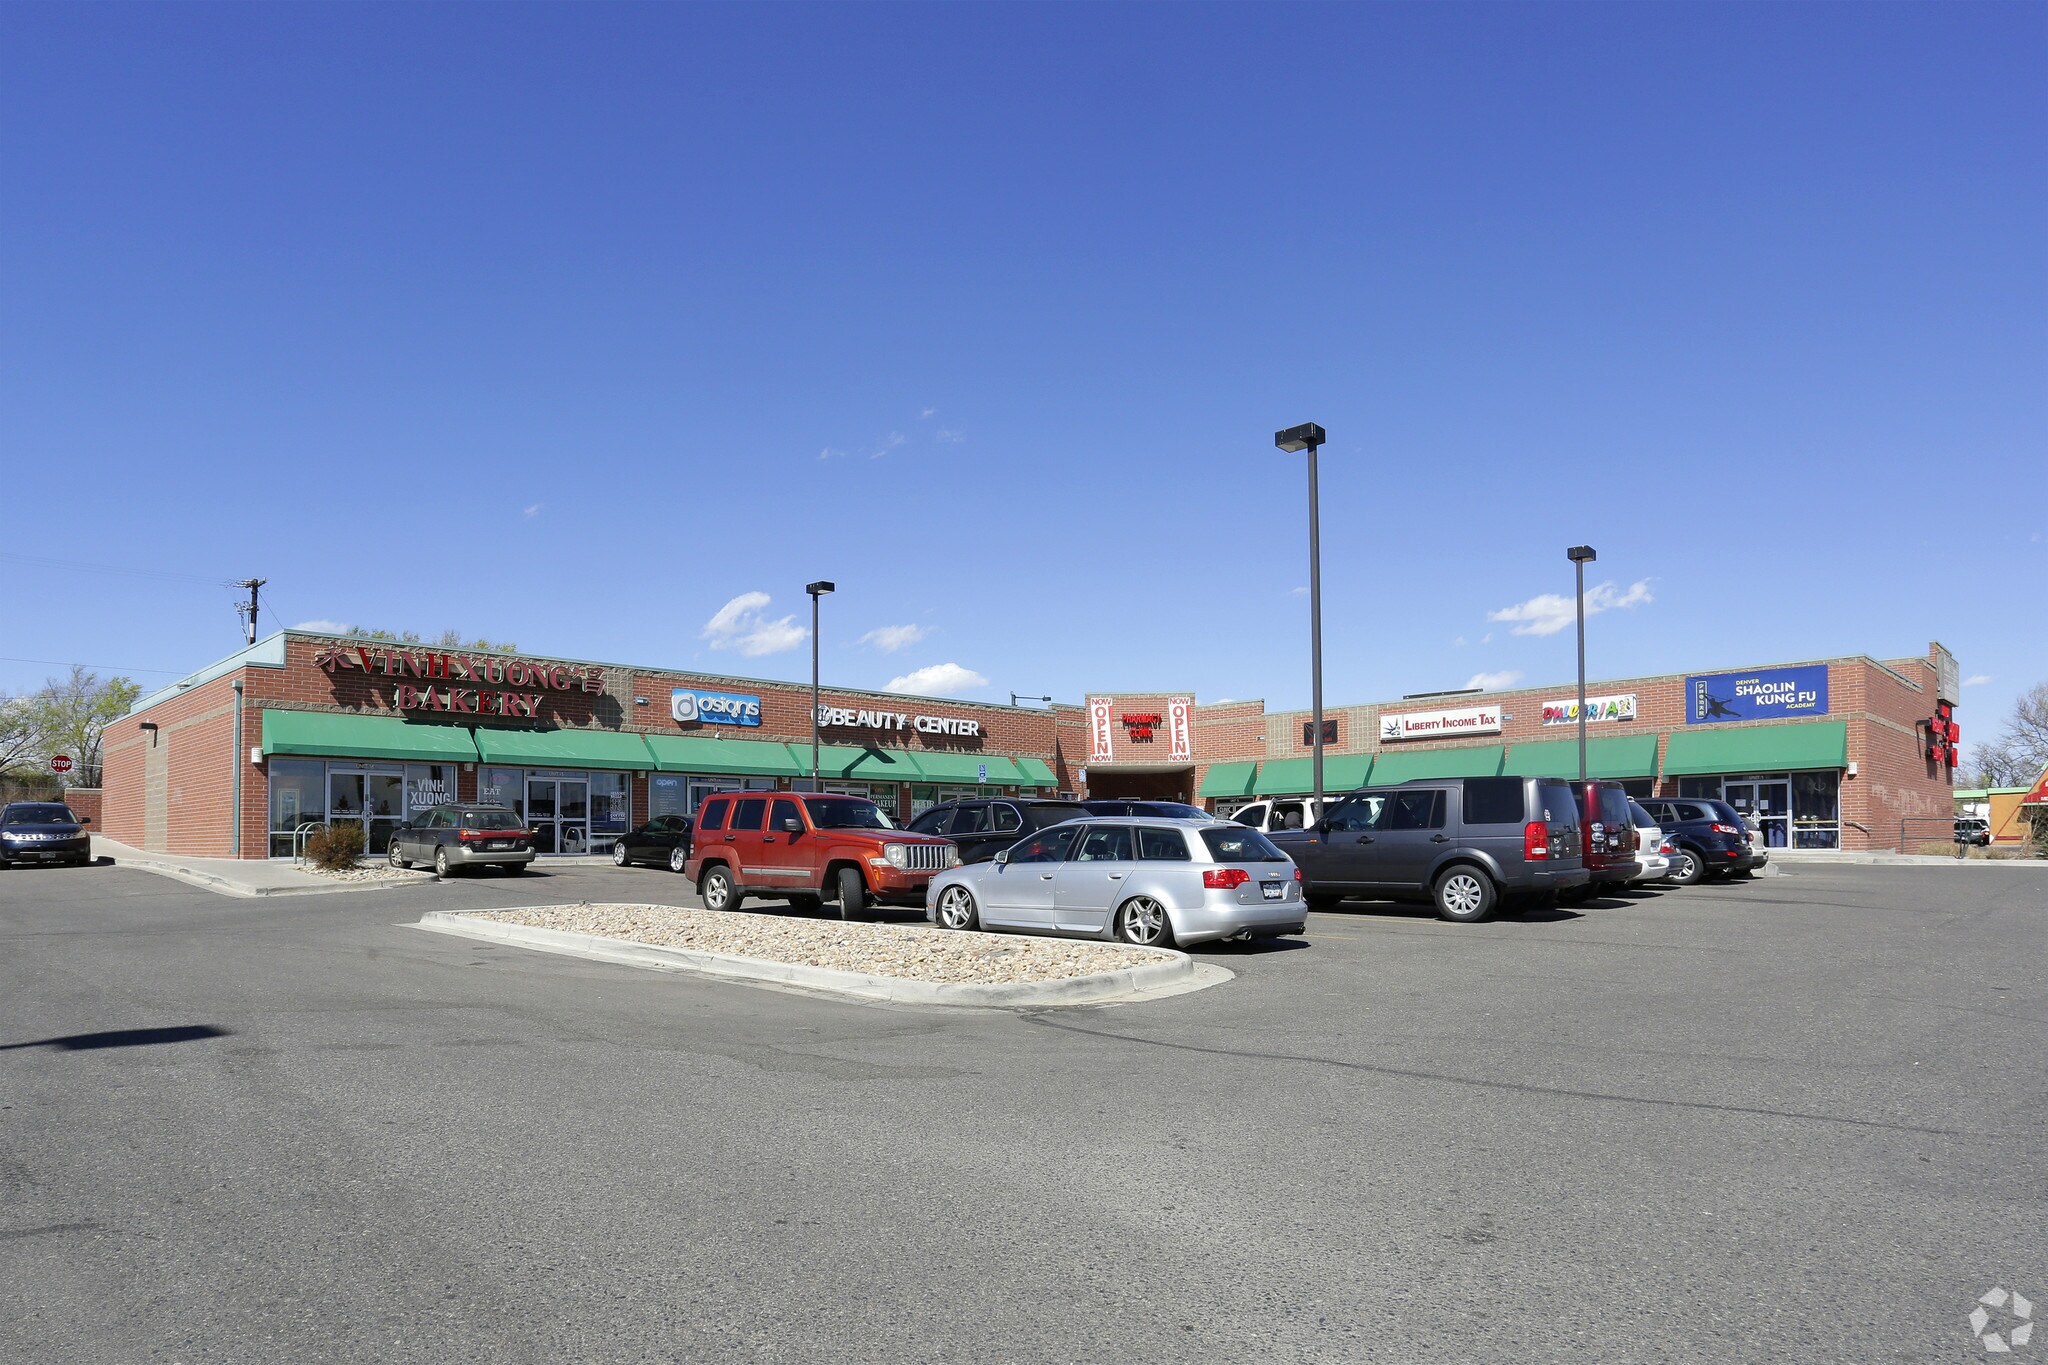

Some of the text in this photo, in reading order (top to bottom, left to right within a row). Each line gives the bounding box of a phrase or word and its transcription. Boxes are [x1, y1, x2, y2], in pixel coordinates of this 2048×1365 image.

[356, 647, 451, 679] VINH
[1736, 682, 1795, 696] SHAOLIN
[393, 682, 544, 718] BAKERY
[1756, 691, 1816, 705] KUNG FU
[1542, 701, 1618, 719] DULCRIA
[830, 708, 907, 730] BEAUTY
[914, 715, 979, 736] CENTER
[1121, 713, 1162, 723] PHARMACY
[1095, 706, 1108, 754] OPEN
[1129, 727, 1153, 737] CLINIC
[1173, 706, 1186, 753] OPEN
[417, 779, 444, 792] VINH
[656, 779, 678, 787] open
[410, 792, 451, 805] XUONG
[484, 788, 501, 796] EAT
